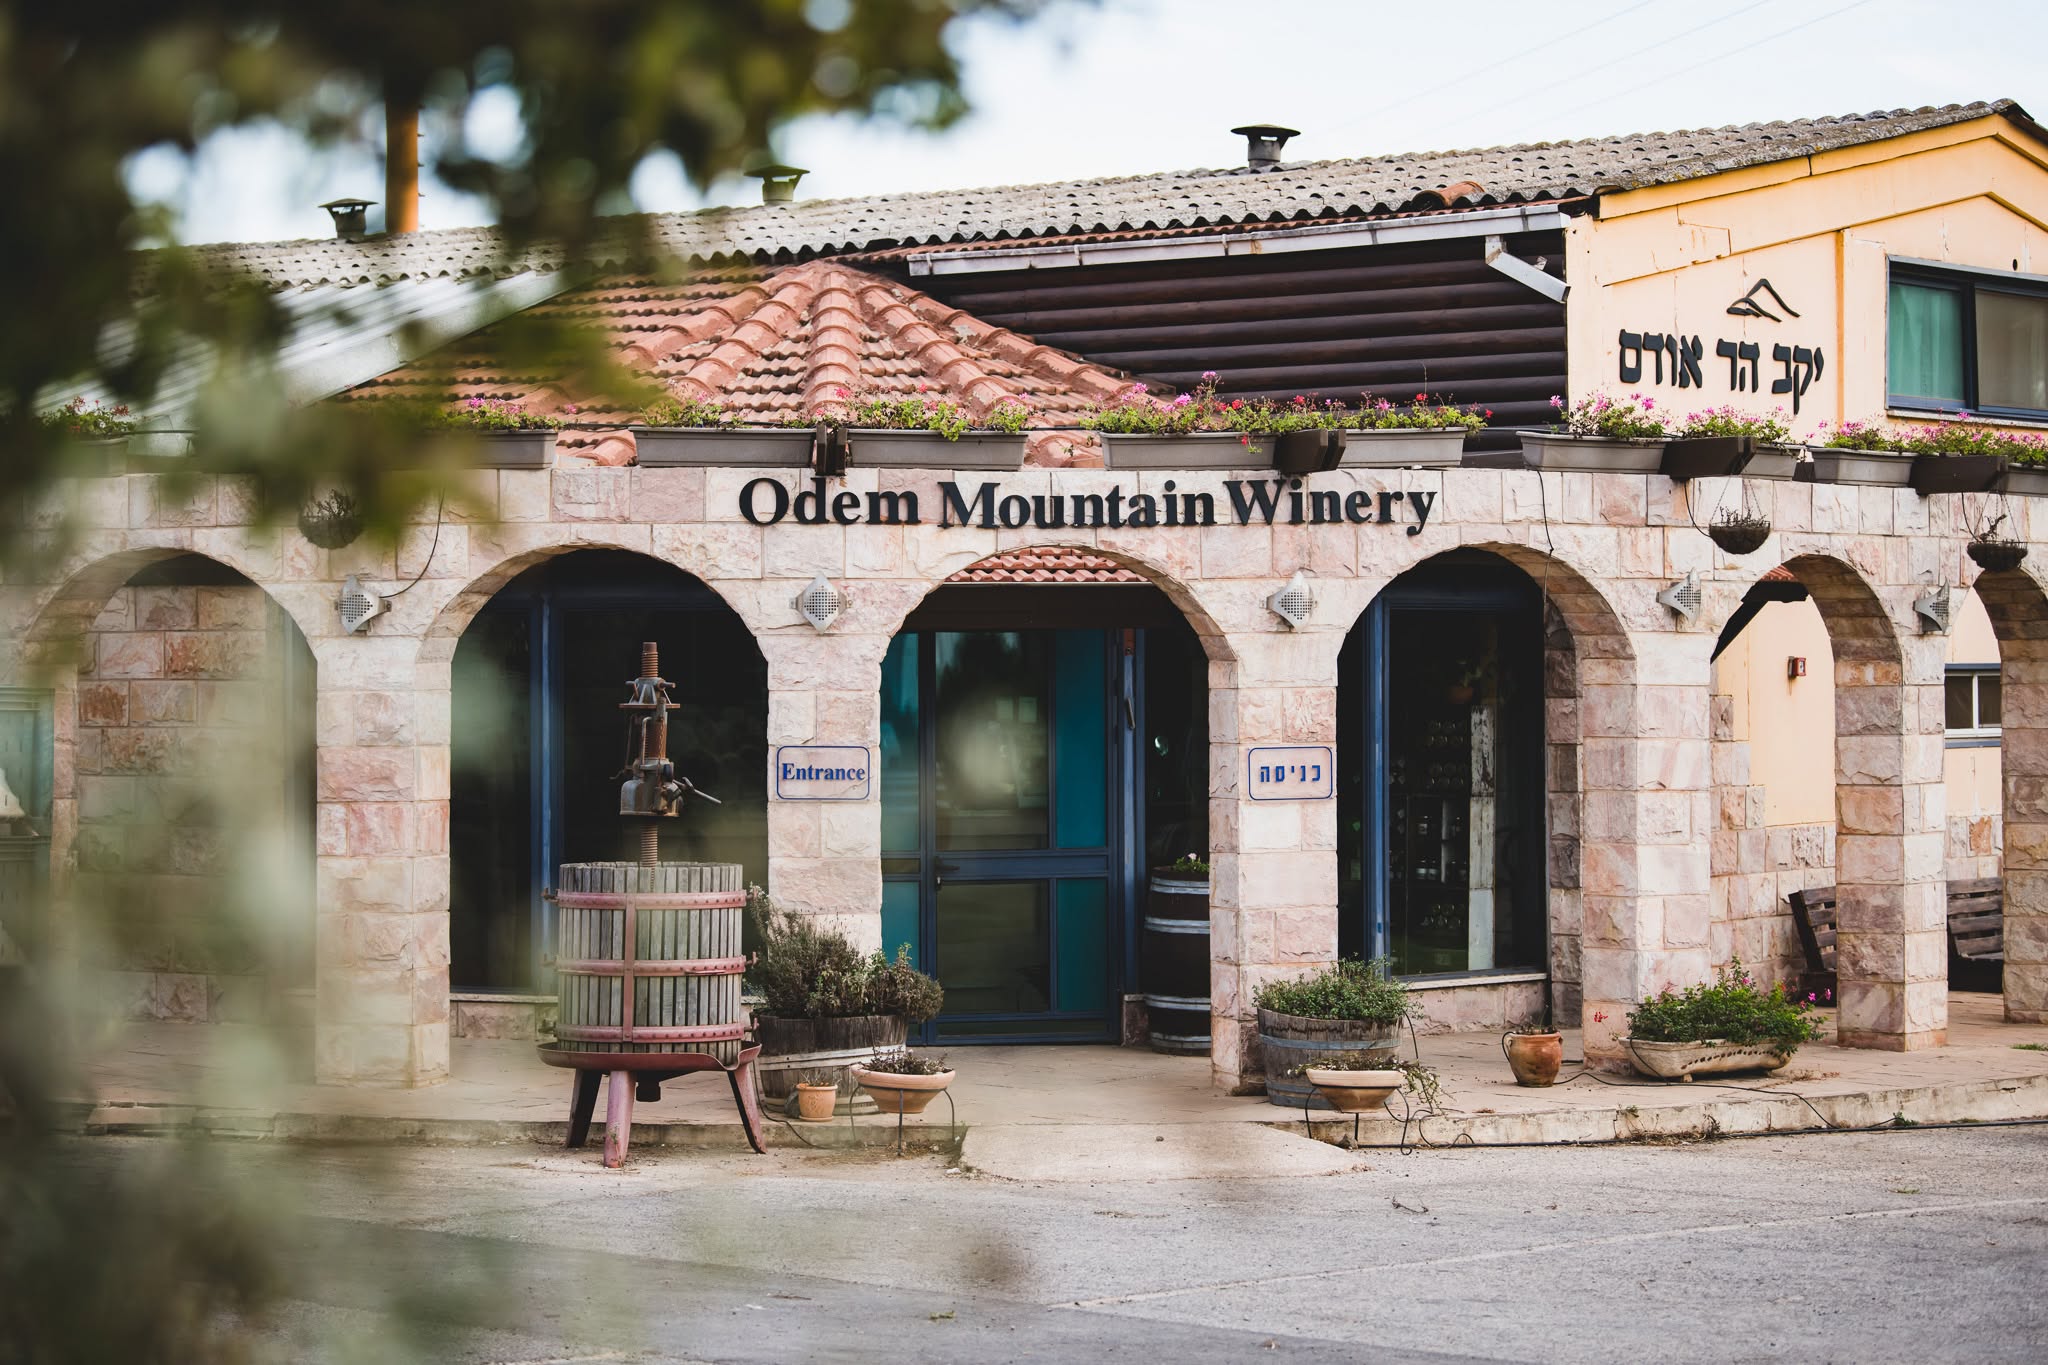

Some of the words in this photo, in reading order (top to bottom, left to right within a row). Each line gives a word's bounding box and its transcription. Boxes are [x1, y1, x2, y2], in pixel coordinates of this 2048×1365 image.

[1618, 328, 1704, 390] אודם
[1715, 338, 1761, 394] הר
[1771, 342, 1825, 416] יקב
[739, 476, 922, 526] Odem
[936, 479, 1219, 529] Mountain
[1223, 476, 1438, 537] Winery
[781, 762, 866, 782] Entrance
[1259, 764, 1322, 784] כניסה
